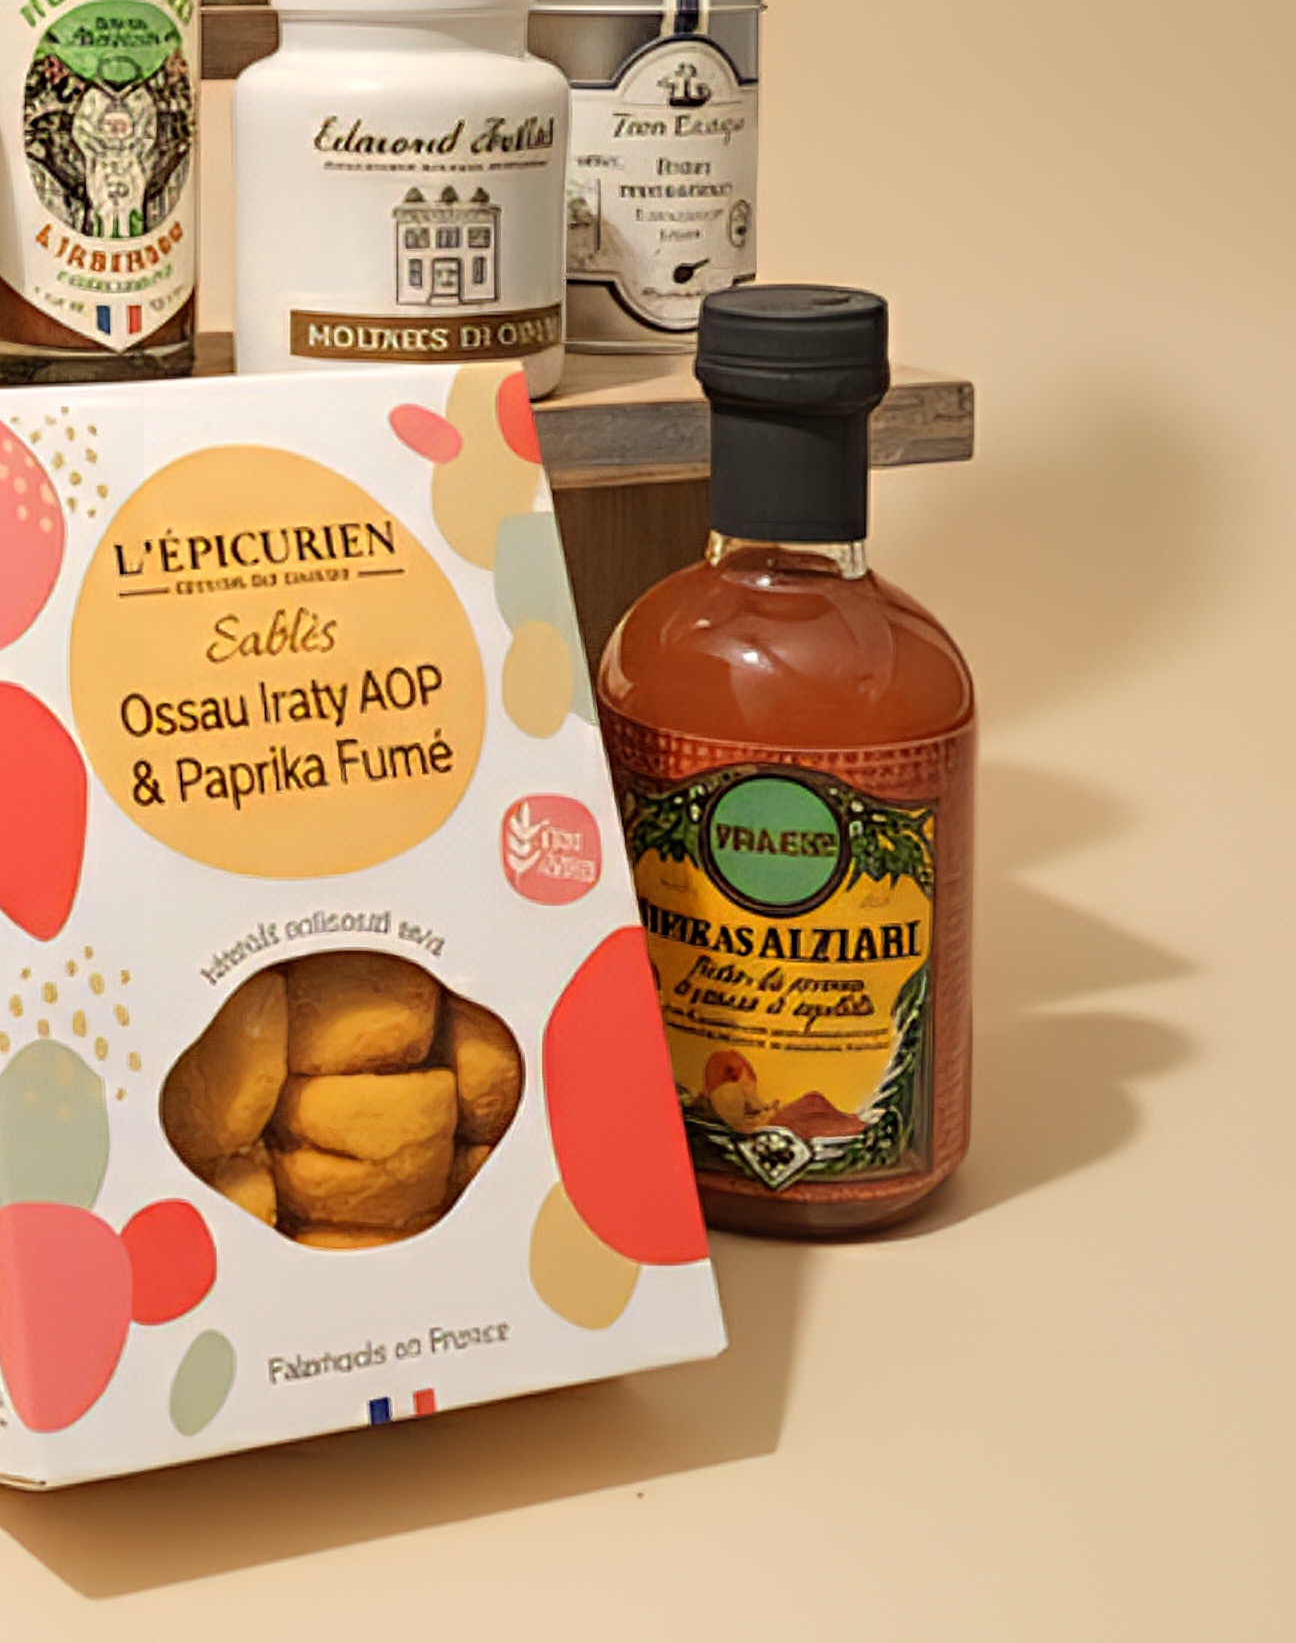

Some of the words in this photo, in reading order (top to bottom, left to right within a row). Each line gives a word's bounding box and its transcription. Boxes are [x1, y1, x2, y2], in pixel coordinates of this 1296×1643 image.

[114, 520, 396, 577] L'ÉPICURIEN
[120, 691, 250, 739] Ossau
[259, 679, 349, 728] Iraty
[359, 663, 444, 715] AOP
[132, 760, 165, 808] &
[176, 746, 329, 811] Paprika
[336, 728, 455, 786] Fumé
